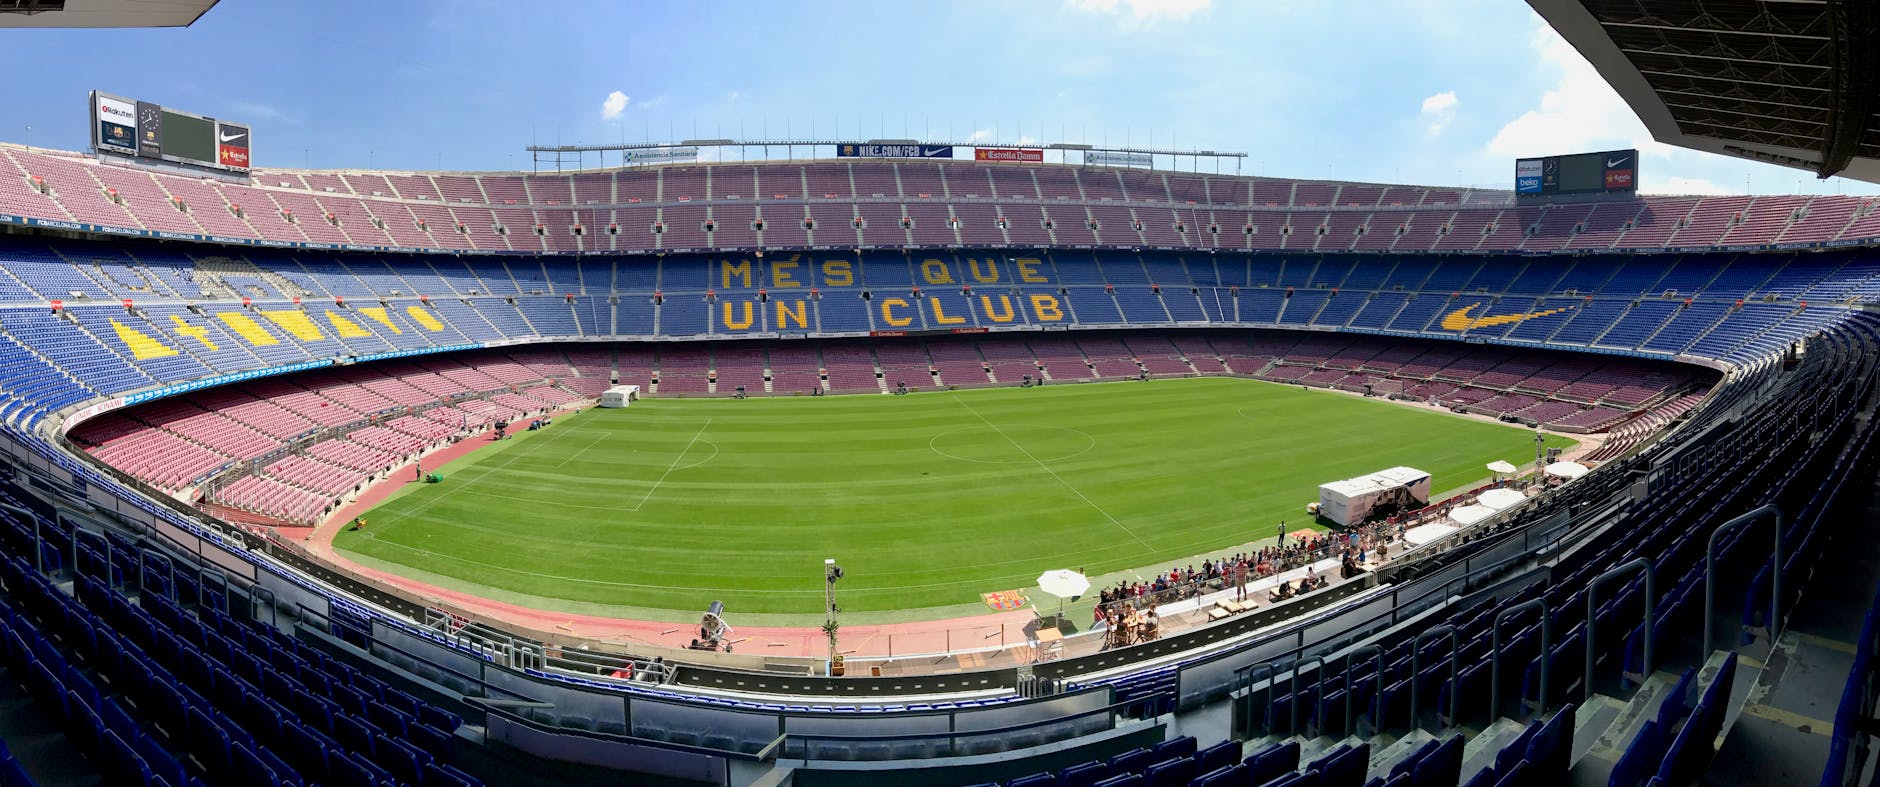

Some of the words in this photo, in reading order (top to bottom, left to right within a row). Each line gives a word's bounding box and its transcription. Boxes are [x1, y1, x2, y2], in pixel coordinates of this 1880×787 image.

[107, 107, 134, 119] Rakuten
[859, 145, 920, 157] NIKE.COM/FCB
[988, 151, 1016, 160] Estrella
[1016, 151, 1040, 160] Damm
[1520, 178, 1538, 186] beko
[37, 219, 81, 230] FCBARCELONA.COM
[102, 226, 141, 235] FCBARCELONA.COM
[721, 254, 853, 288] MÉS
[921, 257, 1048, 284] QUE
[723, 300, 808, 330] UN
[881, 294, 1064, 327] CLUB
[97, 399, 123, 412] KONAMI
